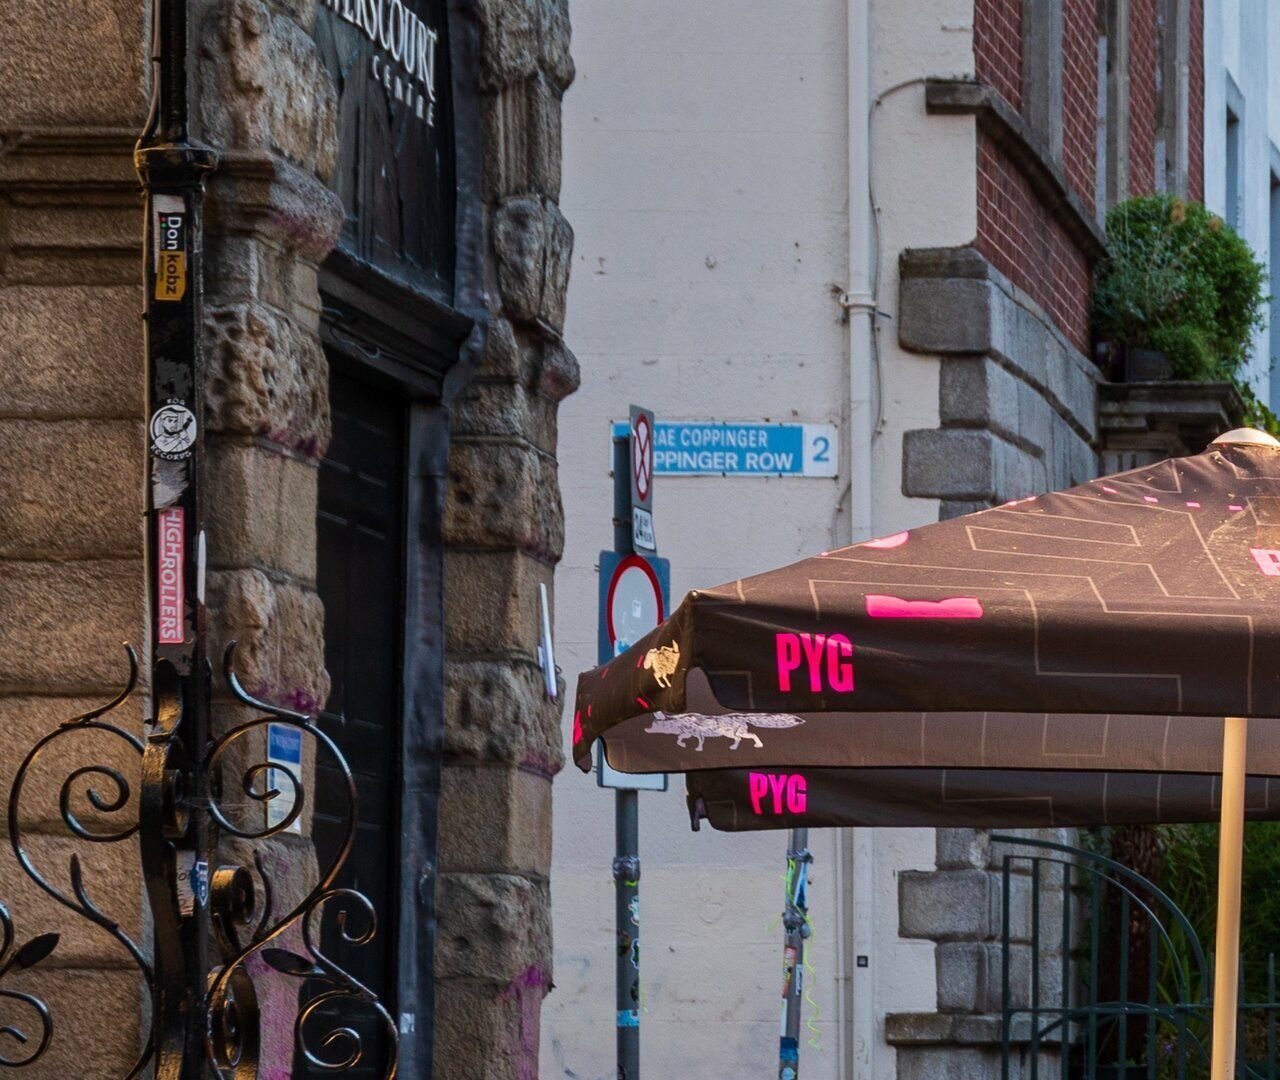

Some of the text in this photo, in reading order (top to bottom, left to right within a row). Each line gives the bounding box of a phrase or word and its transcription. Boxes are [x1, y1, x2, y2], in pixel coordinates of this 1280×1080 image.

[373, 55, 434, 127] CENTRE
[680, 428, 768, 447] COPPINGER
[812, 436, 830, 463] 2
[653, 451, 793, 470] PPINGER ROW
[775, 632, 855, 693] PYG
[749, 772, 808, 814] PYG
